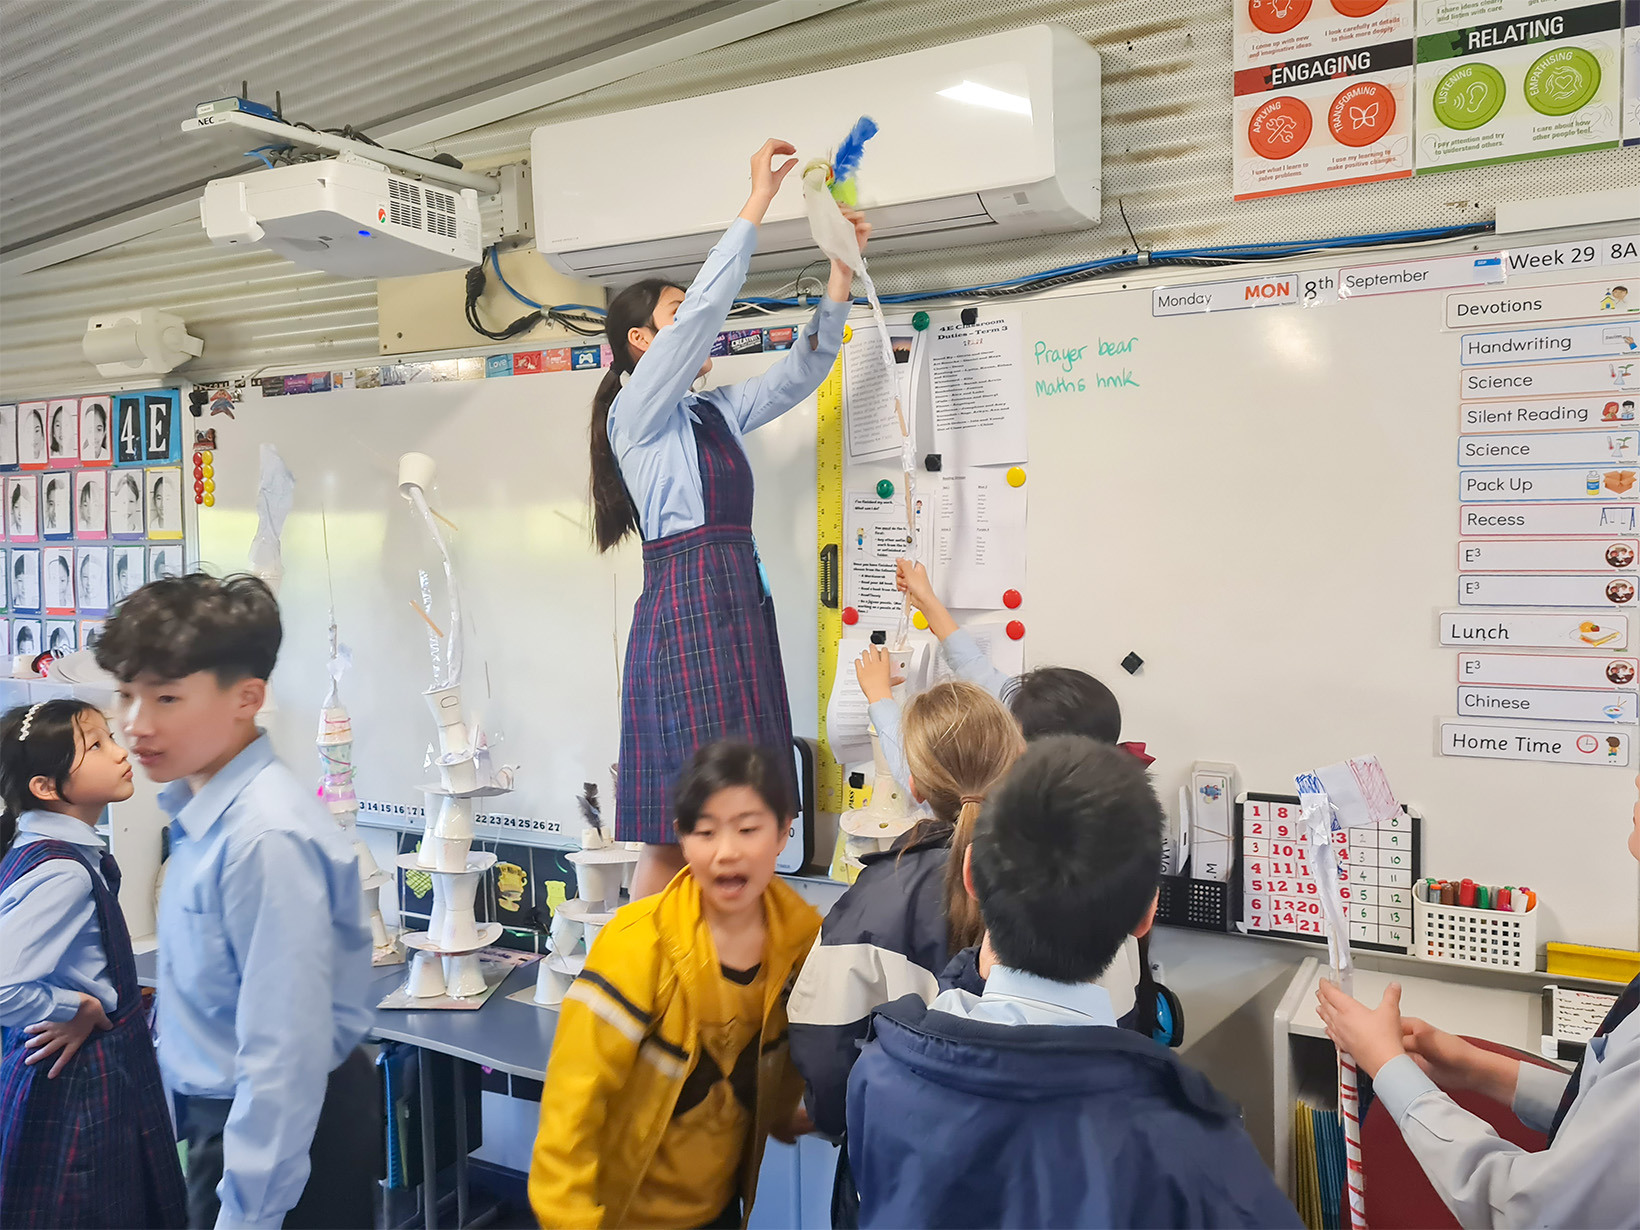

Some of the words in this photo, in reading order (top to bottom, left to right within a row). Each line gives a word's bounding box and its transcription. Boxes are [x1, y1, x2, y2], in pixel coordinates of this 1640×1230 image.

[1441, 5, 1459, 14] share
[1461, 2, 1478, 10] ideas
[1450, 11, 1469, 20] listen
[1471, 8, 1486, 17] with
[1343, 23, 1370, 33] carefully
[1379, 17, 1400, 27] details
[1339, 32, 1354, 41] think
[1355, 30, 1371, 38] more
[1468, 15, 1564, 50] RELATING
[1273, 40, 1280, 48] up
[1281, 37, 1294, 45] with
[1249, 51, 1260, 59] and
[1261, 45, 1295, 57] imaginative
[1272, 51, 1371, 86] ENGAGING
[1529, 51, 1573, 97] EMPATHISING
[1438, 67, 1473, 105] LISTENING
[1332, 86, 1377, 133] TRANSFORMING
[198, 116, 214, 126] NEC
[1253, 101, 1282, 134] APPLYING
[1537, 124, 1553, 132] care
[1554, 121, 1574, 130] about
[1575, 119, 1591, 127] how
[1438, 140, 1449, 149] pay
[1450, 135, 1481, 146] attention
[1482, 133, 1494, 142] and
[1495, 132, 1505, 141] try
[1533, 133, 1550, 141] other
[1552, 130, 1575, 141] people
[1348, 154, 1357, 162] my
[1358, 150, 1383, 160] learning
[1443, 143, 1480, 155] understand
[1267, 165, 1282, 174] what
[1327, 163, 1343, 171] make
[1345, 159, 1368, 169] positive
[1258, 174, 1273, 182] solve
[1509, 249, 1564, 269] Week
[1571, 246, 1595, 264] 29
[1610, 242, 1638, 259] 8A
[1158, 291, 1212, 308] Monday
[1245, 281, 1290, 301] MON
[1304, 276, 1334, 300] 8th
[1346, 268, 1429, 290] September
[1457, 297, 1543, 316] Devotions
[975, 327, 1000, 335] Term
[1468, 335, 1572, 355] Handwriting
[1034, 341, 1088, 373] Prayer
[1098, 336, 1139, 357] bear
[1035, 377, 1087, 398] Maths
[1096, 367, 1140, 389] hmk
[1468, 375, 1533, 390] Science
[1467, 409, 1512, 424] Silent
[1517, 406, 1589, 423] Reading
[1465, 443, 1530, 457] Science
[1467, 475, 1504, 491] Pack
[1510, 479, 1533, 493] Up
[1467, 513, 1525, 526] Recess
[1451, 623, 1510, 641] Lunch
[1464, 694, 1530, 710] Chinese
[1453, 733, 1508, 751] Home
[1514, 736, 1562, 754] Time
[368, 802, 378, 811] 14
[381, 804, 391, 812] 15
[394, 805, 405, 814] 16
[475, 814, 487, 823] 22
[489, 816, 501, 825] 23
[504, 817, 516, 827] 24
[518, 819, 531, 828] 25
[533, 821, 546, 830] 26
[548, 822, 560, 832] 27
[1253, 806, 1261, 816] 1
[1277, 807, 1288, 818] 8
[1253, 823, 1262, 834] 2
[1278, 825, 1288, 837] 9
[1332, 832, 1347, 843] 3
[1391, 836, 1398, 846] 9
[1253, 842, 1258, 852] 3
[1273, 844, 1293, 856] 10
[1359, 851, 1365, 862] 3
[1391, 856, 1401, 864] 10
[1251, 863, 1261, 874] 4
[1273, 863, 1292, 874] 11
[1360, 871, 1367, 881] 4
[1252, 880, 1262, 891] 5
[1267, 880, 1288, 892] 12
[1297, 882, 1317, 894] 19
[1360, 890, 1367, 900] 5
[1391, 893, 1401, 903] 12
[1252, 899, 1261, 910] 6
[1274, 899, 1294, 910] 13
[1297, 901, 1319, 914] 20
[1361, 908, 1367, 918] 6
[1390, 912, 1400, 922] 13
[1251, 916, 1261, 927] 7
[1273, 913, 1294, 925] 14
[1300, 919, 1321, 933] 21
[1361, 926, 1366, 936] 7
[1390, 931, 1400, 940] 14
